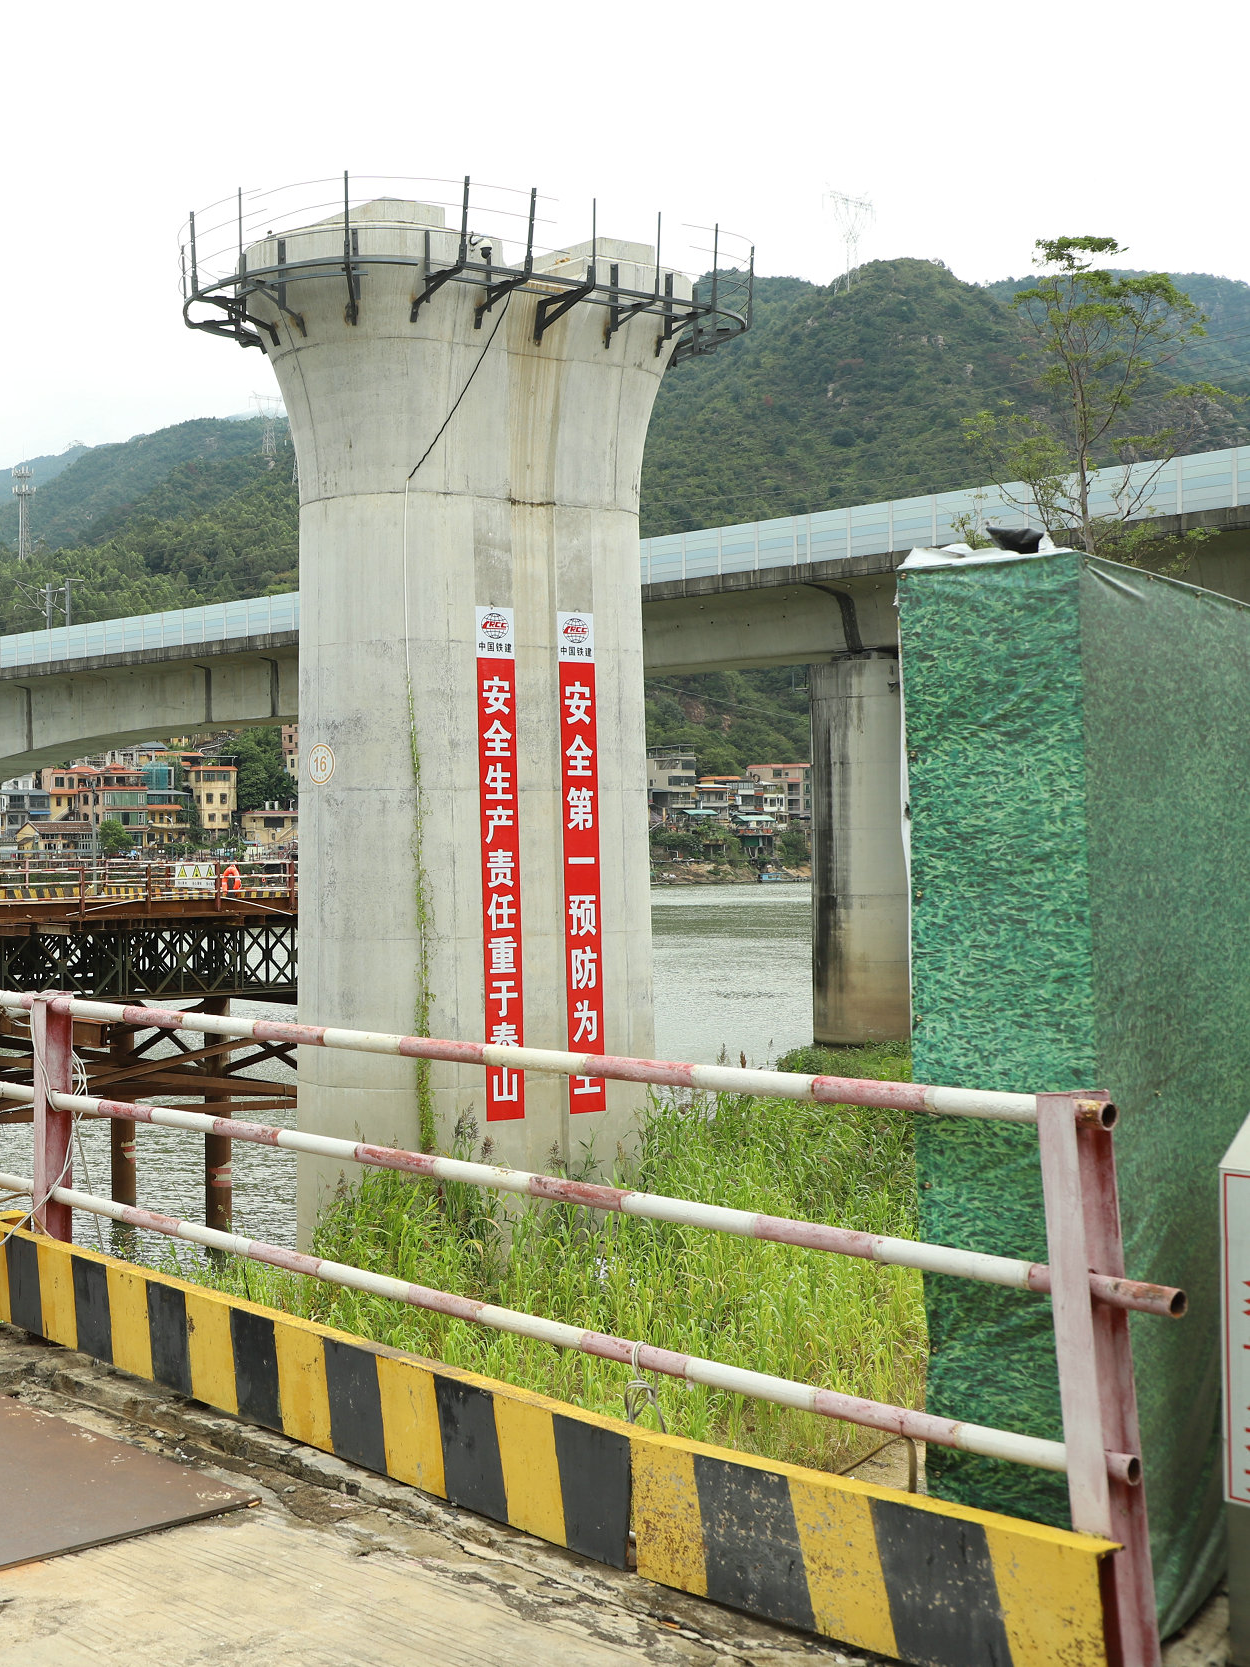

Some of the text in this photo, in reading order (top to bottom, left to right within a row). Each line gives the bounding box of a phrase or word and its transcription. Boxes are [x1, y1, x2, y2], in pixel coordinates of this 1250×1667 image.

[482, 621, 509, 630] CRCC
[563, 626, 589, 634] CRCC
[478, 641, 512, 653] 中国铁建
[560, 646, 592, 657] 中国铁建
[313, 755, 327, 773] 16
[482, 676, 519, 1102] 安全生产责任重于泰山
